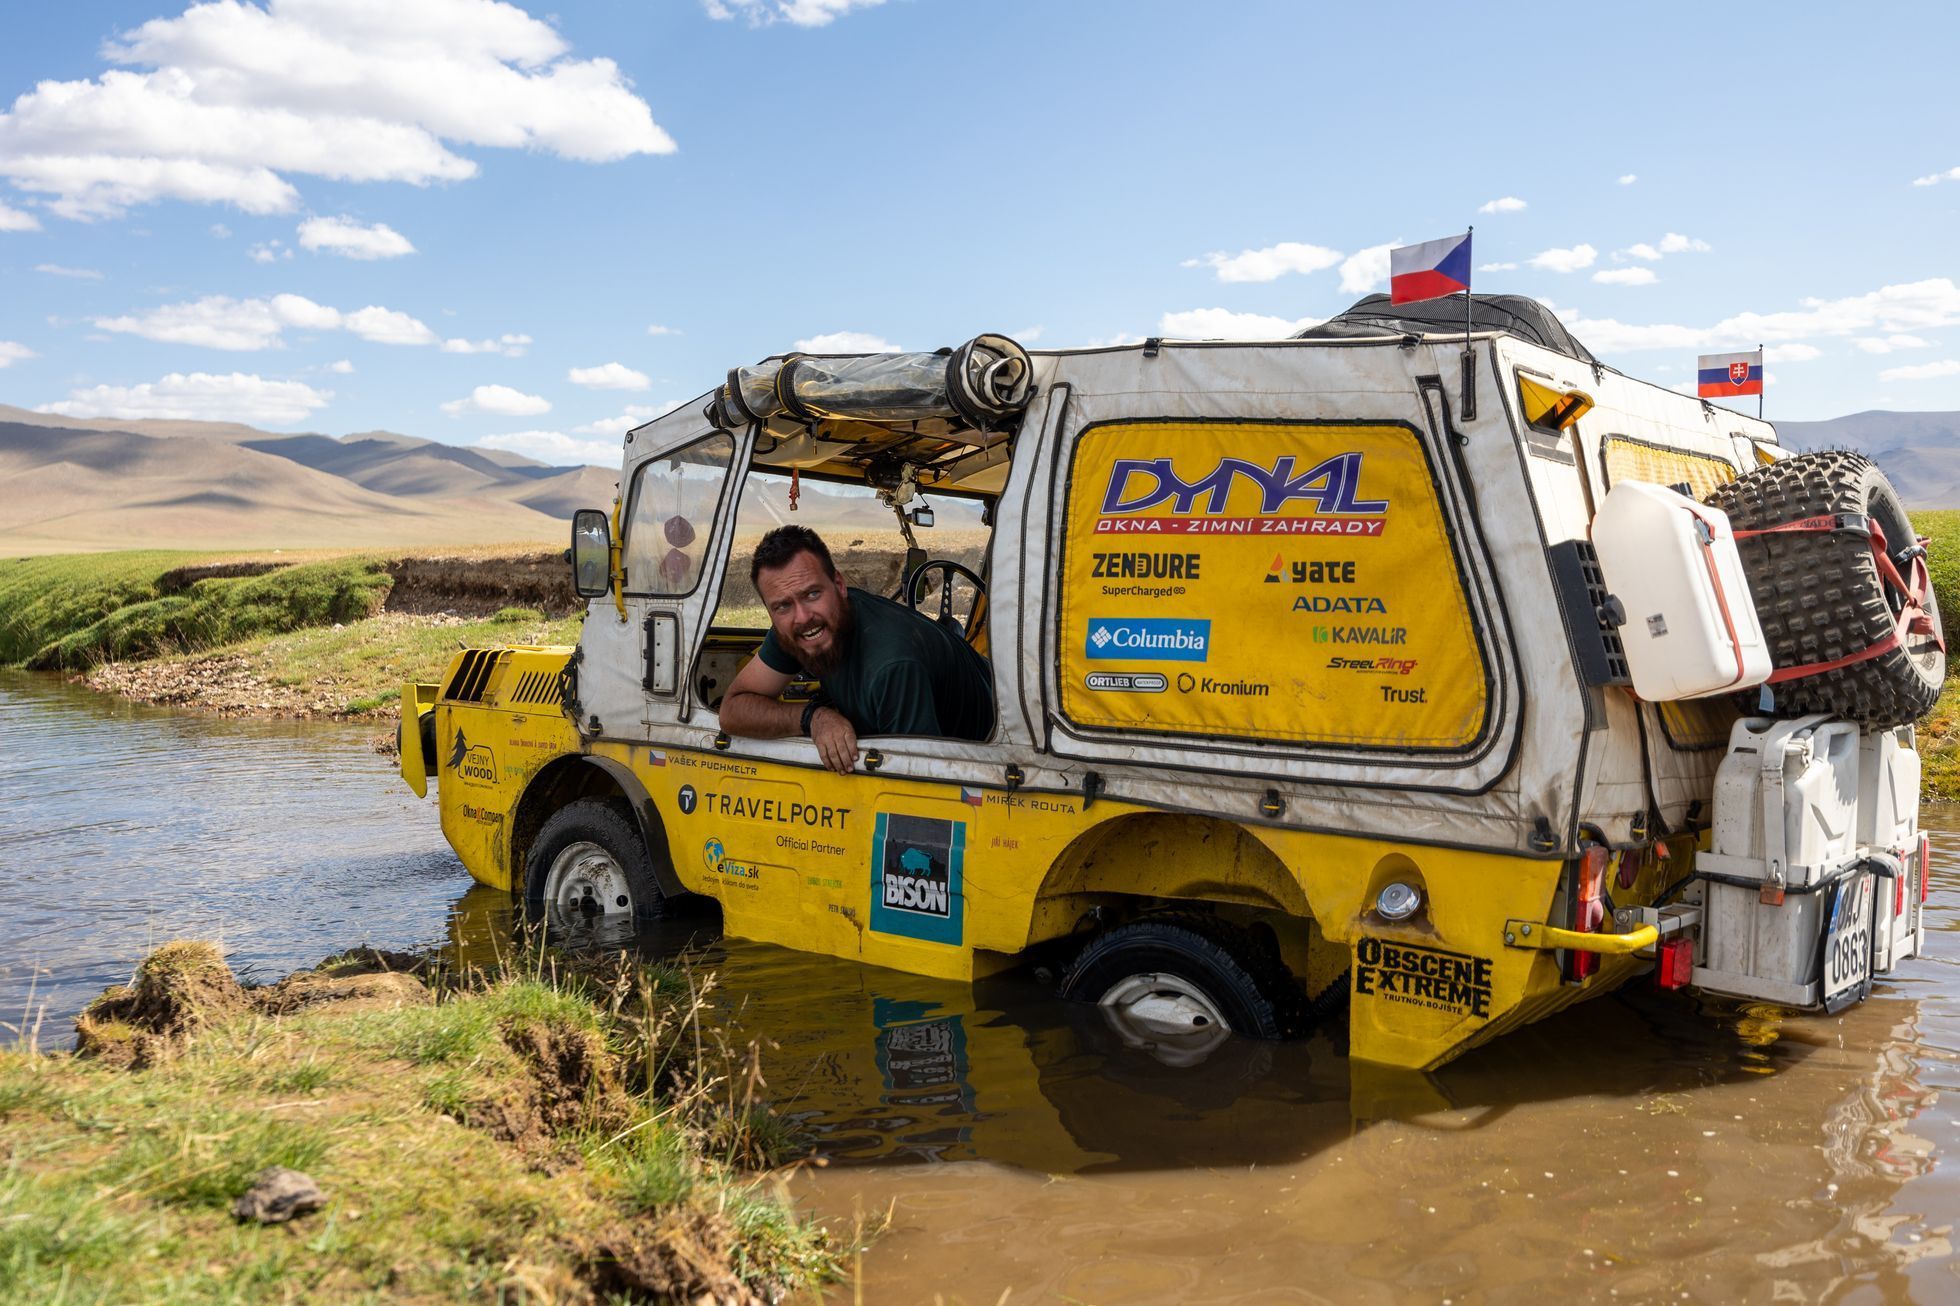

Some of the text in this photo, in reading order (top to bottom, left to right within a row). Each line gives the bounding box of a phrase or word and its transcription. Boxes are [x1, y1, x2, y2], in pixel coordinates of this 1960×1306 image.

[1100, 452, 1389, 514] DYNAL
[1097, 520, 1162, 532] OKNA
[1187, 518, 1255, 532] ZIMNÍ
[1260, 520, 1382, 533] ZAHRADY
[1091, 553, 1200, 579] ZENDURE
[1102, 586, 1172, 598] SuperCharged
[1292, 596, 1387, 614] ADATA
[1112, 627, 1204, 649] Columbia
[1089, 676, 1130, 687] ORTLIEB
[1201, 678, 1269, 696] Kronium
[464, 765, 493, 780] WOOD
[668, 755, 757, 775] VAŠEK PUCHMELTR
[705, 793, 851, 829] TRAVELPORT
[986, 794, 1076, 815] MIREK ROUTA
[776, 835, 846, 856] Official Partner
[885, 873, 947, 913] BISON
[1357, 936, 1493, 989] OBSCENE
[1832, 928, 1868, 984] 0863
[1356, 965, 1491, 1019] EXTREME
